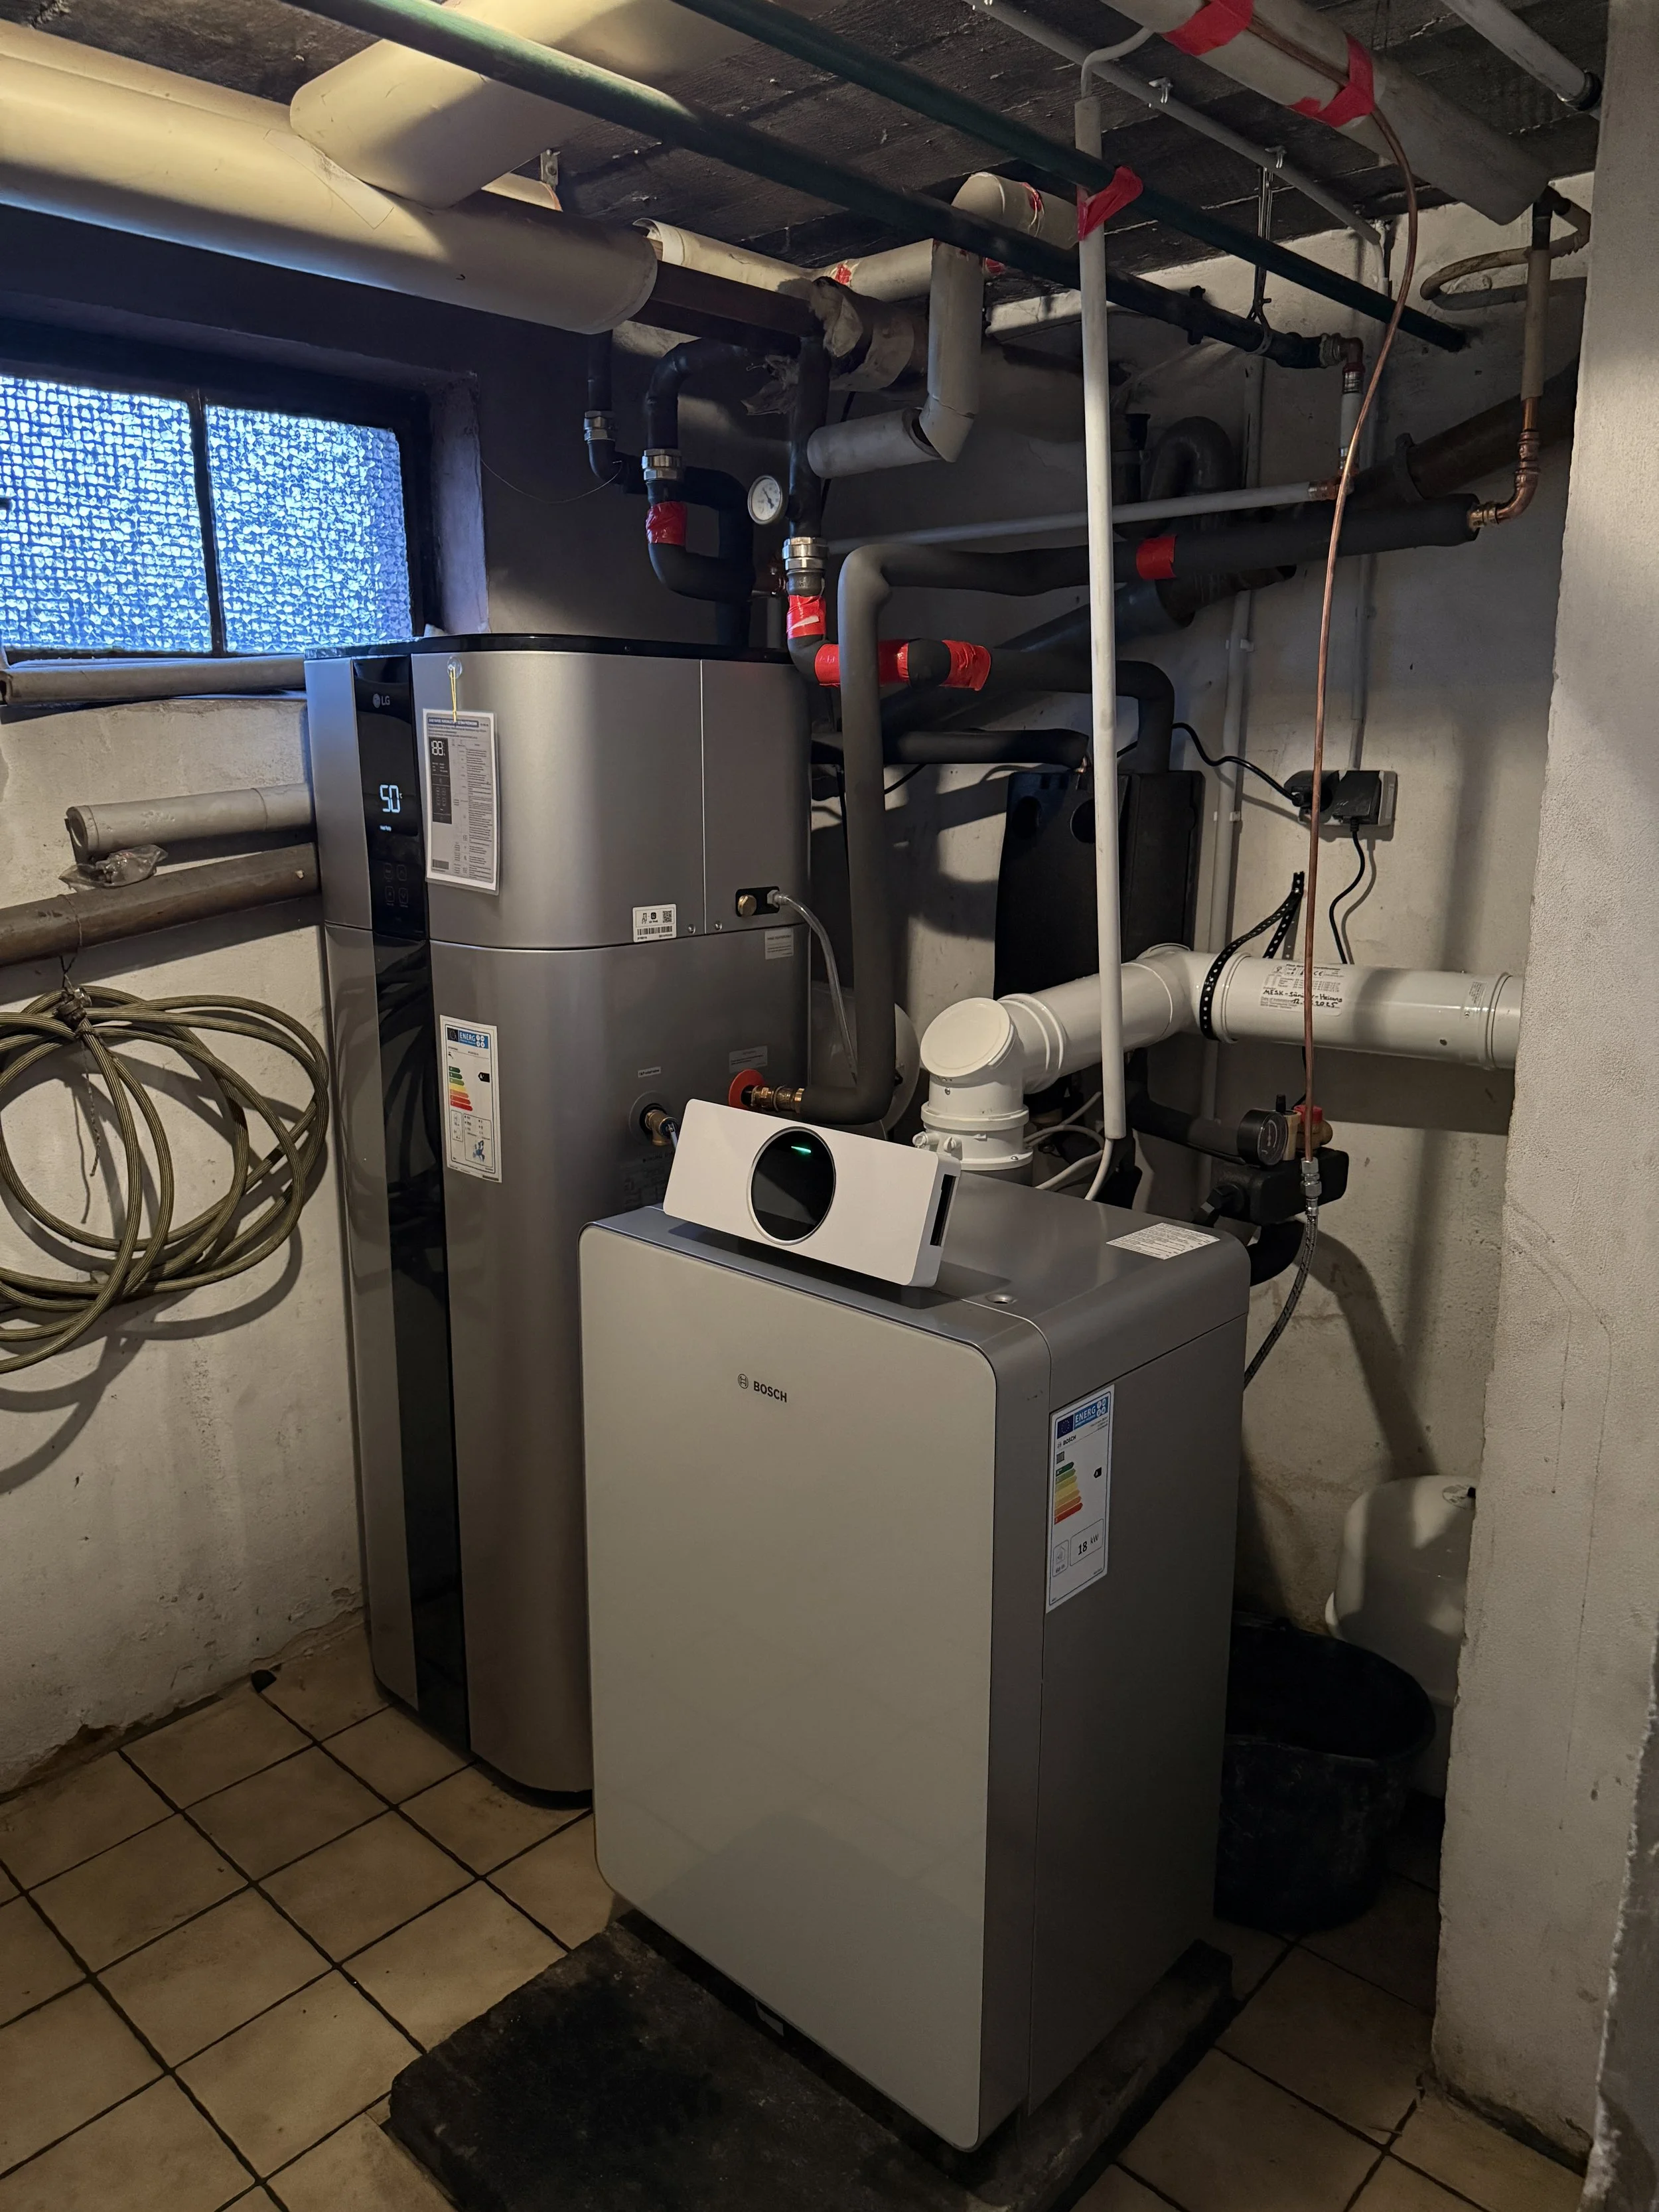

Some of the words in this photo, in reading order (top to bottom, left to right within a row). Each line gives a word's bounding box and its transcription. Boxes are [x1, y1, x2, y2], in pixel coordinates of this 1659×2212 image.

[382, 696, 390, 705] LG
[380, 784, 400, 813] 50
[460, 1031, 476, 1042] ENERG
[754, 1380, 787, 1402] BOSCH
[1075, 1406, 1096, 1423] ENERG
[1063, 1435, 1076, 1445] BOSCH
[1078, 1540, 1088, 1555] 18
[1090, 1532, 1099, 1544] kW
